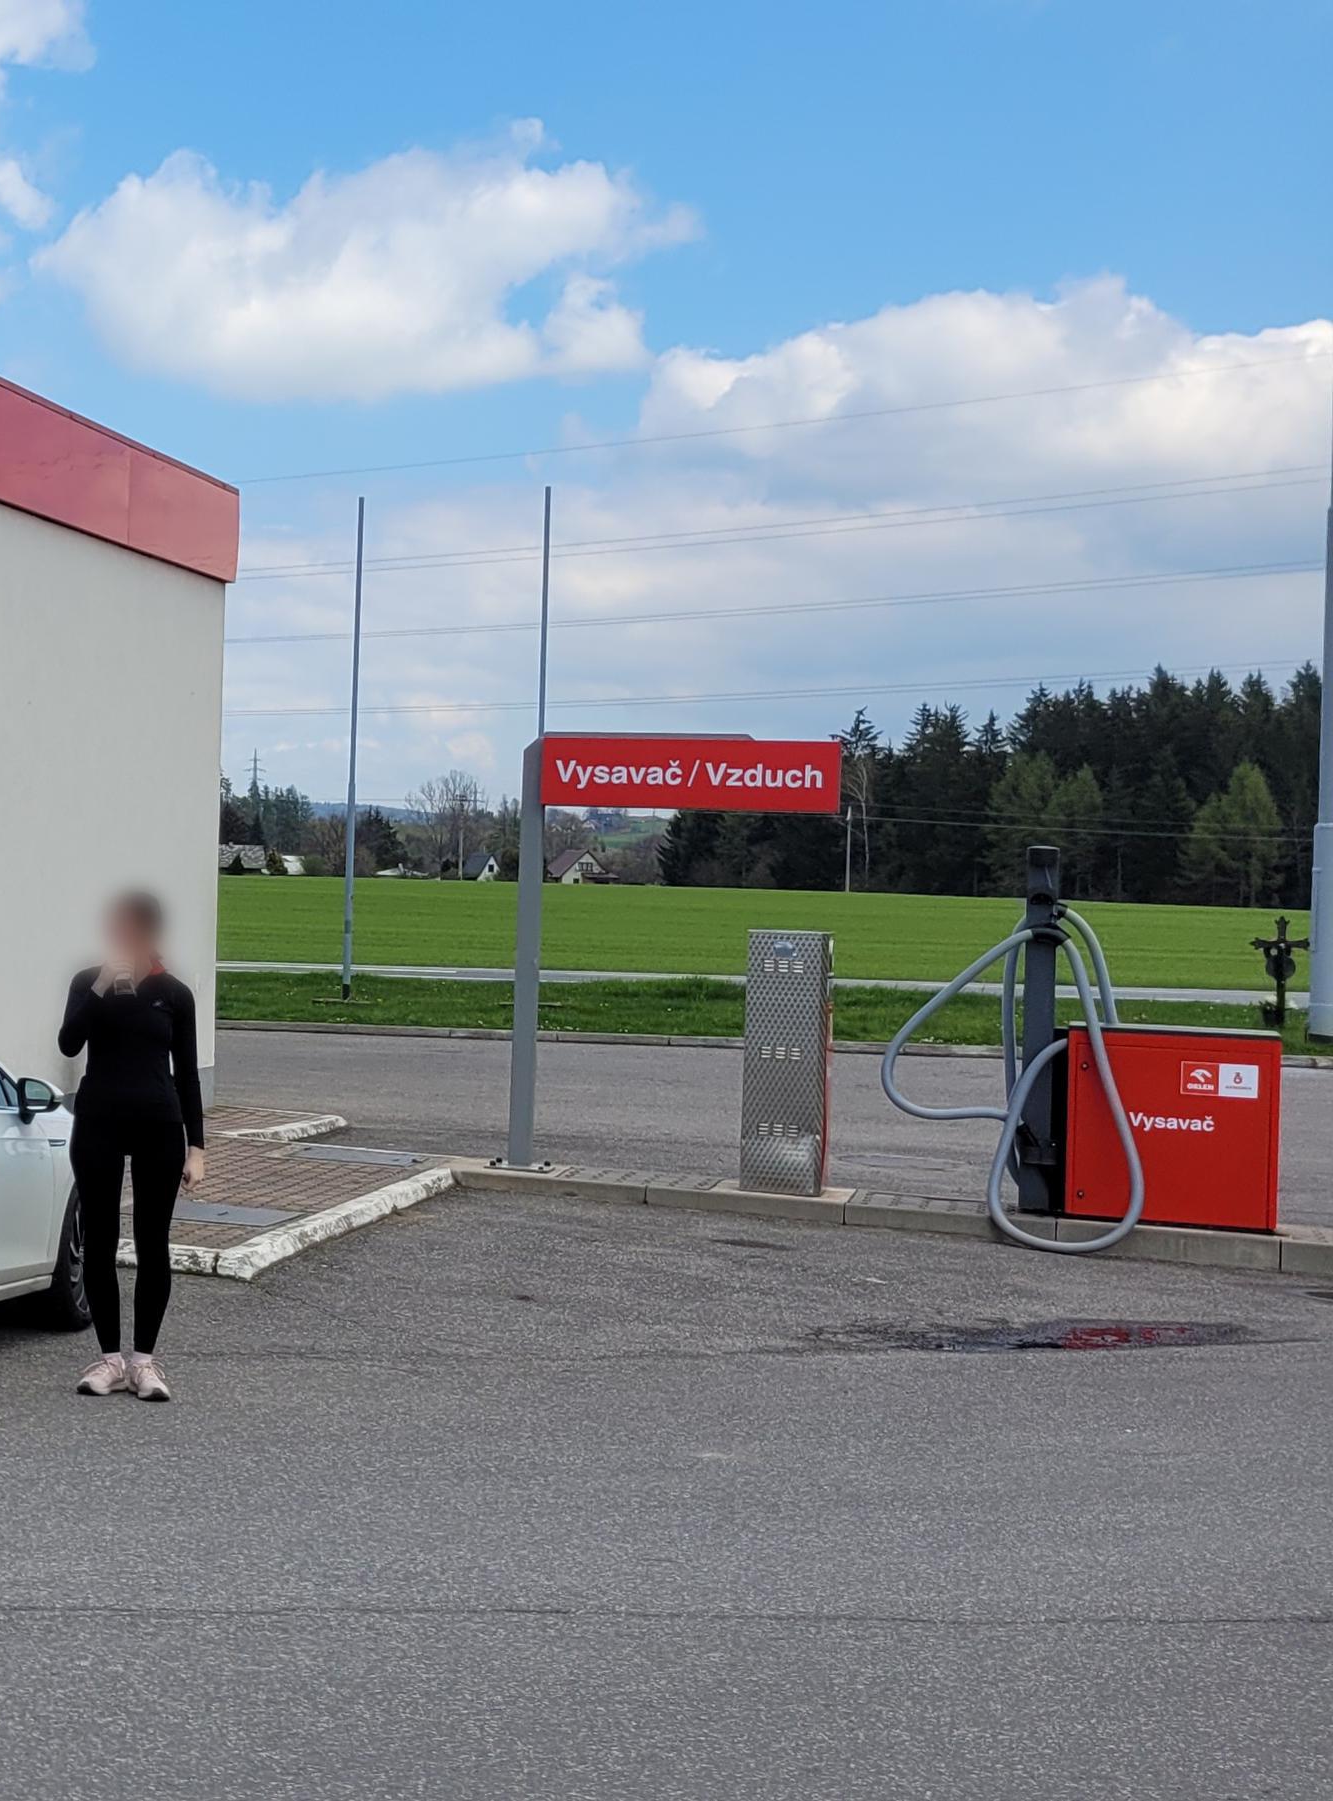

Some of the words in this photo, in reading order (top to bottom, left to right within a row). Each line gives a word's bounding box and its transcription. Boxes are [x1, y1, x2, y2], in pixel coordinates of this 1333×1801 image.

[555, 759, 683, 789] Vysavač
[686, 759, 701, 788] /
[705, 762, 824, 788] Vzduch
[1128, 1111, 1215, 1132] Vysavač
